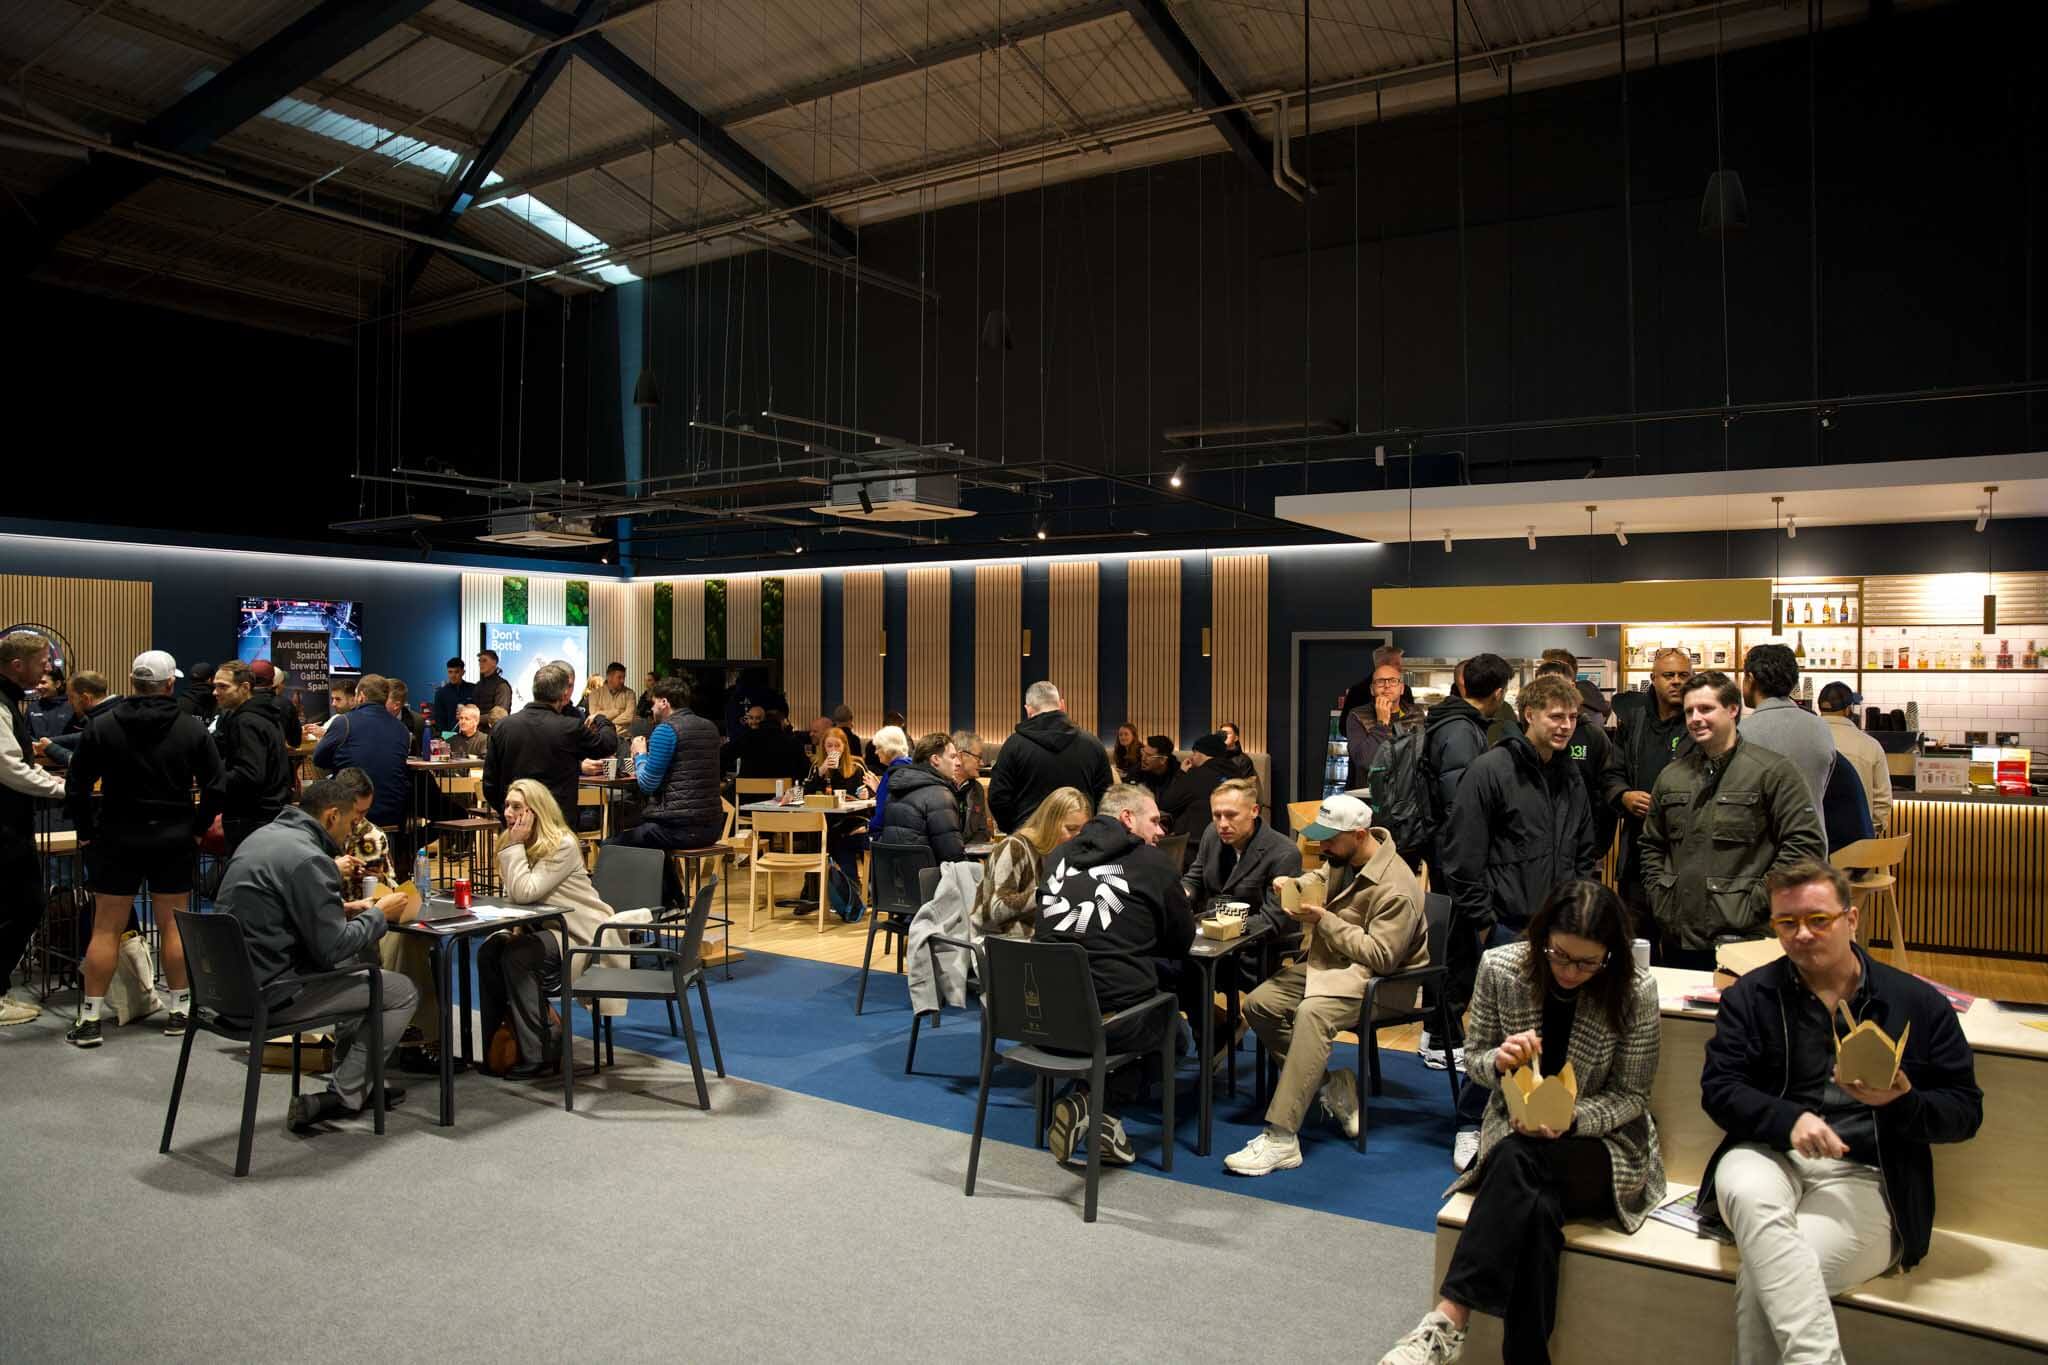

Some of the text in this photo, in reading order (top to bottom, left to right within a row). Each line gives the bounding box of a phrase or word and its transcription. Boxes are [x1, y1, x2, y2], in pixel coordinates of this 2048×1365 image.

[492, 629, 520, 640] Don't
[277, 640, 327, 651] Authentically
[492, 640, 521, 651] Bottle
[296, 650, 328, 661] Spanish,
[290, 660, 328, 670] brewed in
[300, 671, 328, 680] Galicia,
[307, 681, 328, 692] Spain
